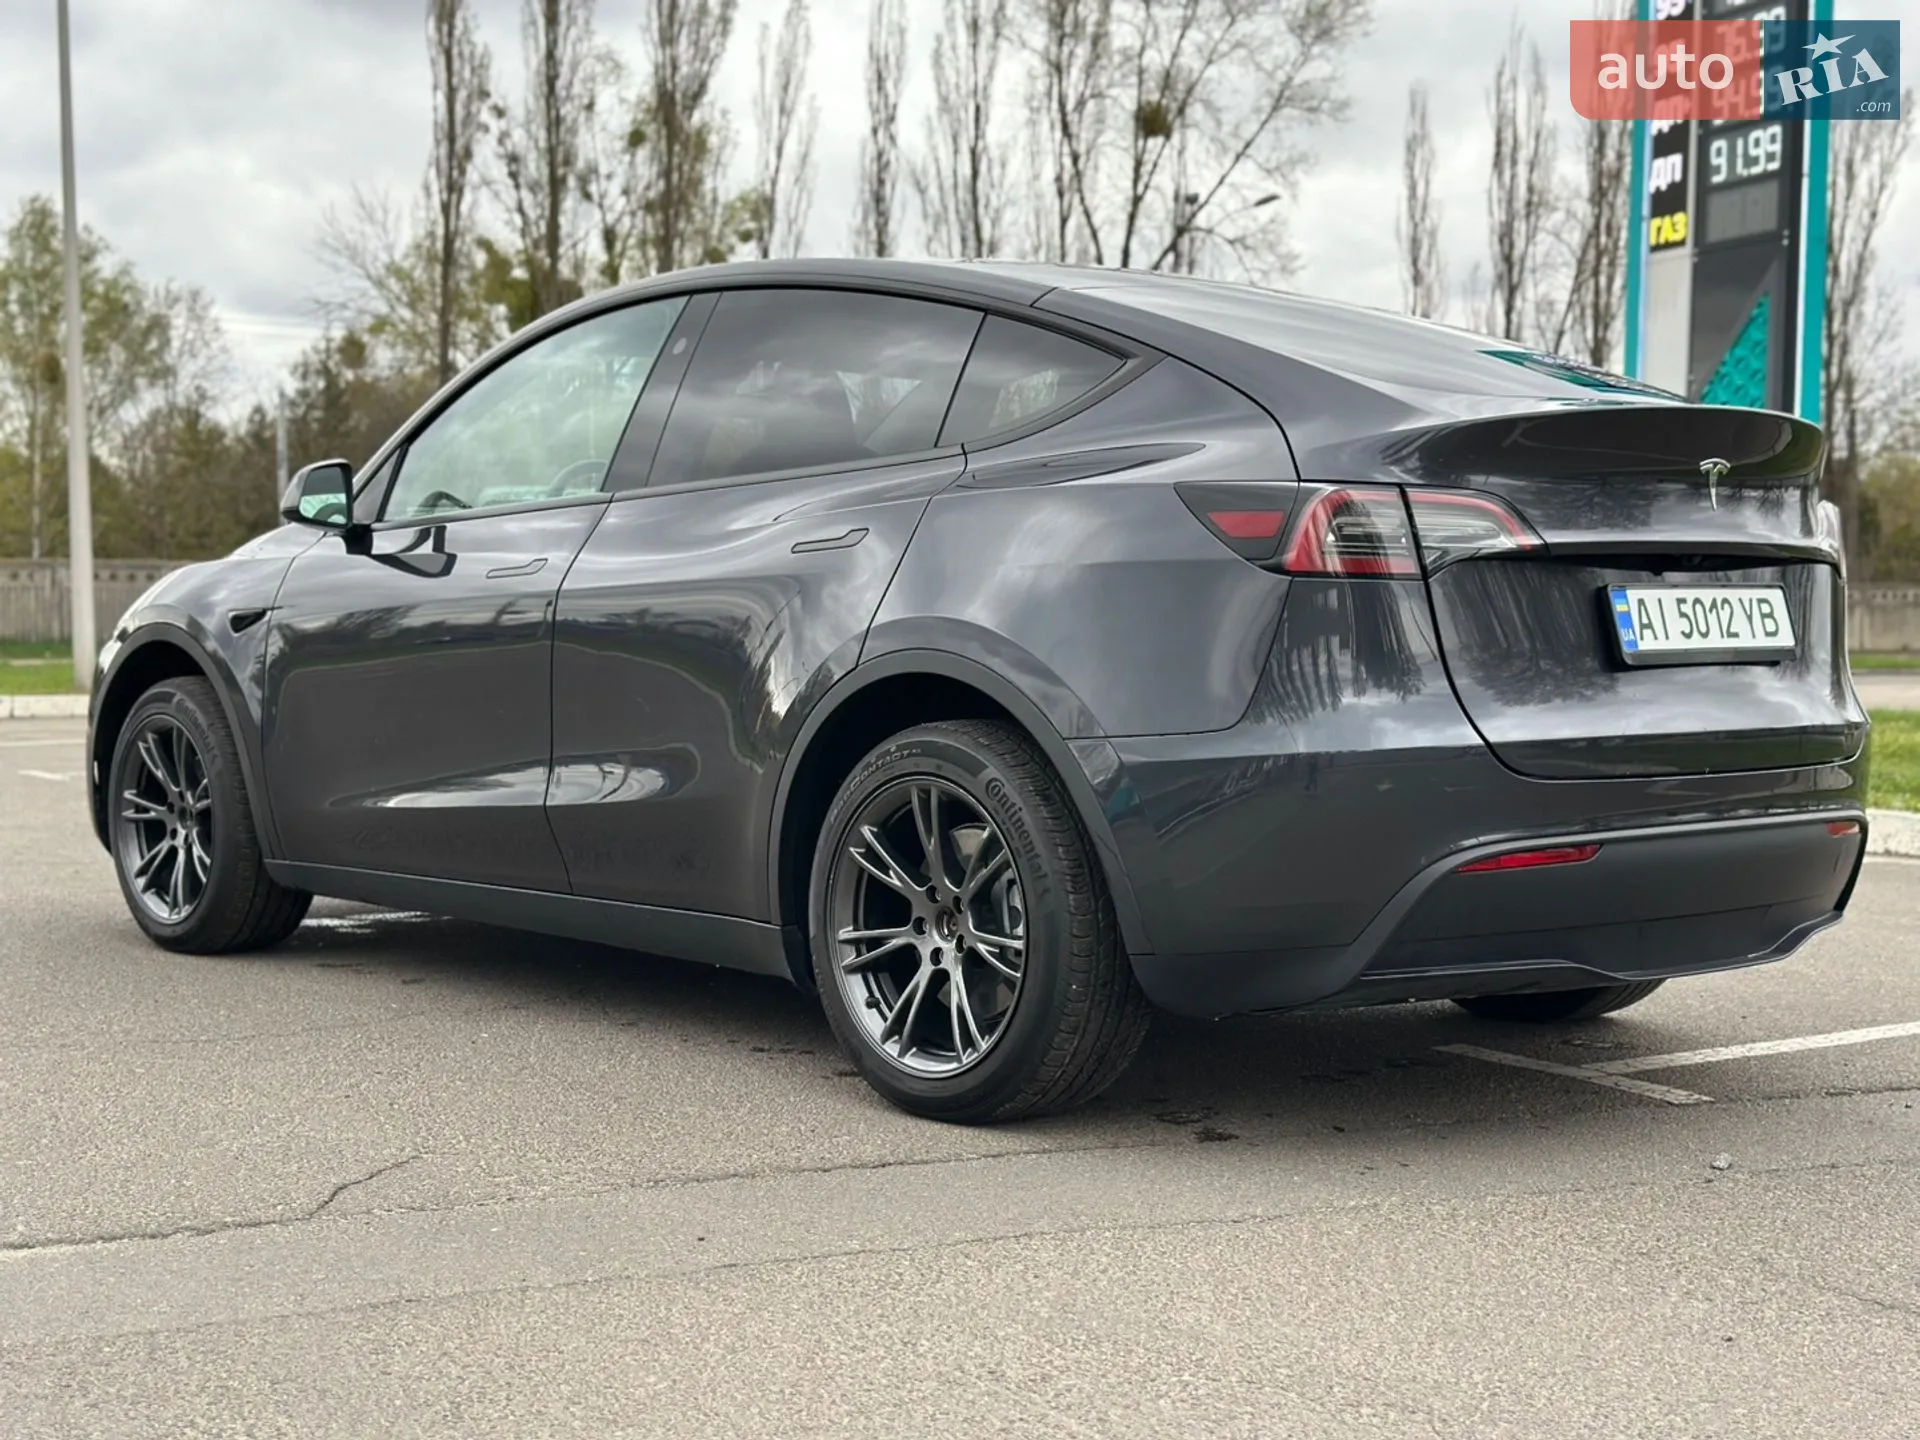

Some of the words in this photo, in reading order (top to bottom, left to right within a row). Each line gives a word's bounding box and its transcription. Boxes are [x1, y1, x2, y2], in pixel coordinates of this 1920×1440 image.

[1649, 152, 1683, 193] ДП
[1710, 124, 1781, 183] 91.99
[1649, 211, 1687, 247] ГАЗ
[1622, 627, 1636, 641] UA
[1637, 598, 1669, 640] AI
[1675, 597, 1740, 639] 5012
[1738, 597, 1779, 639] YB
[985, 777, 1048, 879] Continental
